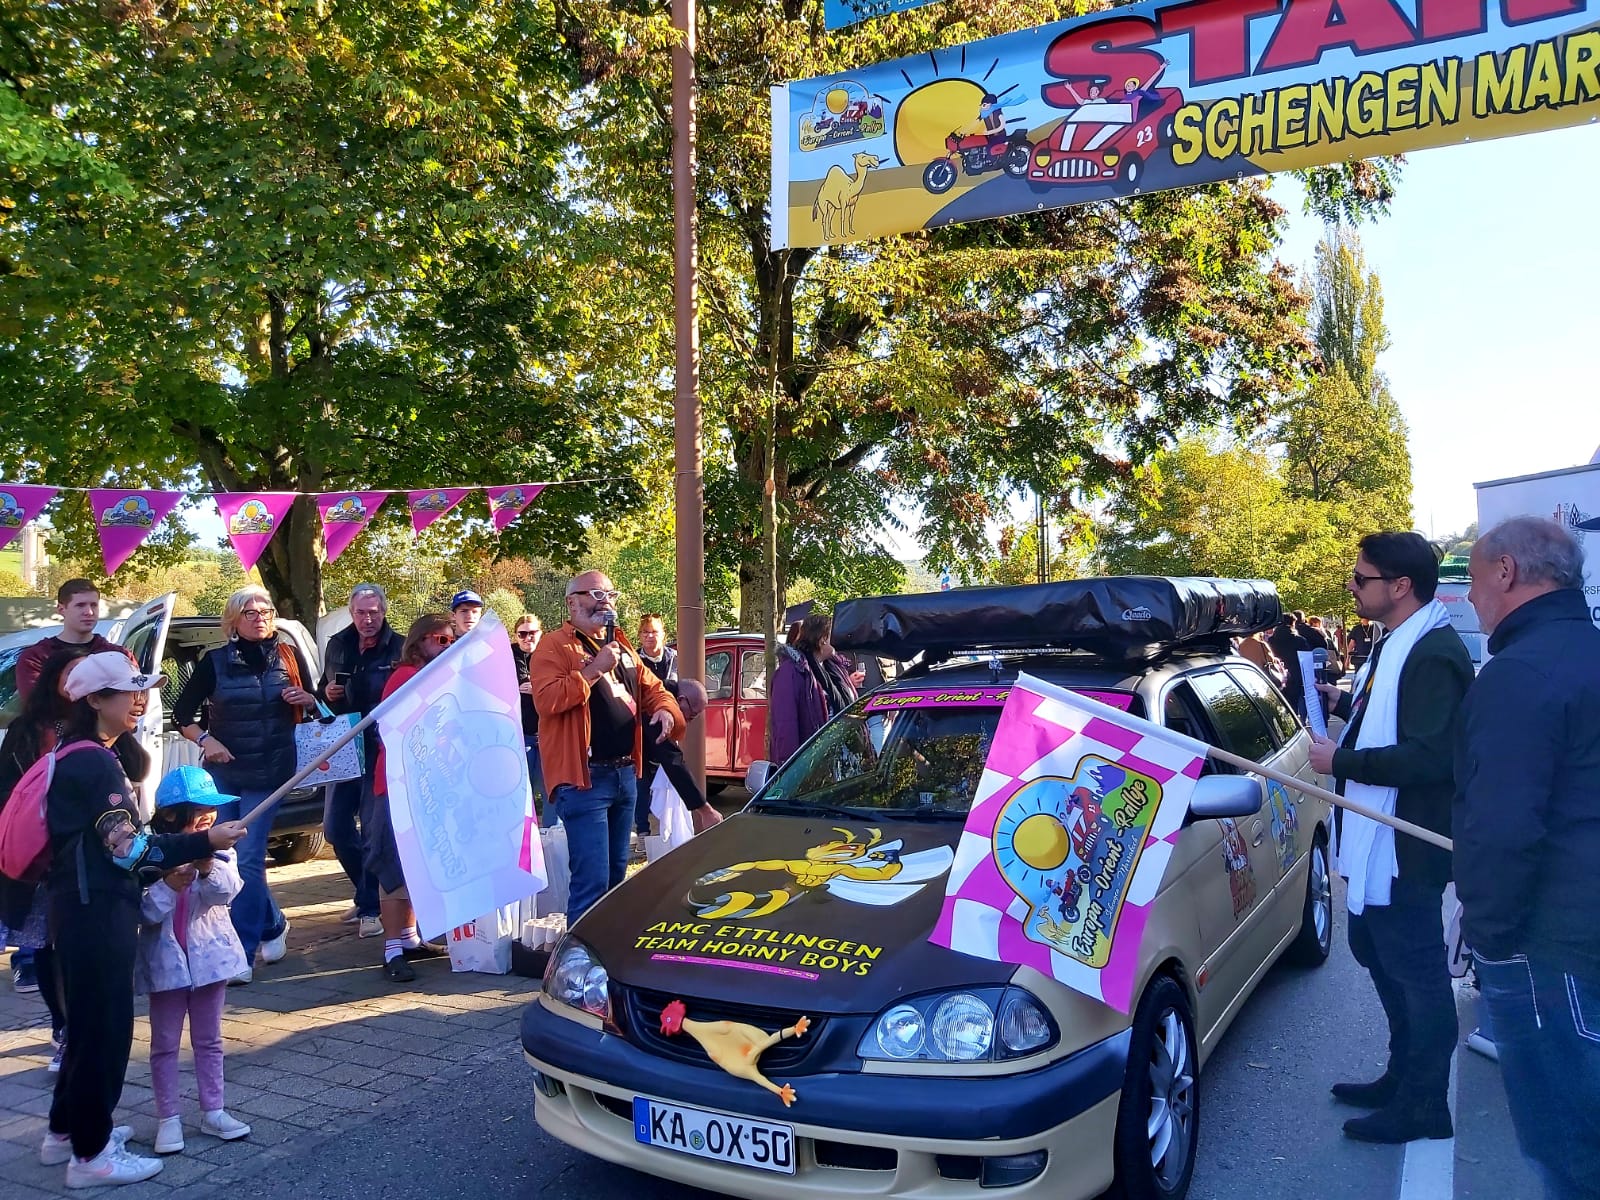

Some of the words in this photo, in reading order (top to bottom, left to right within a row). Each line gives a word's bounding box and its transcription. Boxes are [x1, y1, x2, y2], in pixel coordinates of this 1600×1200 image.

[1172, 55, 1462, 166] SCHENGEN
[1136, 124, 1153, 148] 23
[645, 921, 711, 935] AMC
[714, 925, 883, 959] ETTLINGEN
[1072, 900, 1105, 957] Europa
[634, 936, 700, 951] TEAM
[700, 939, 796, 962] HORNY
[799, 951, 872, 976] BOYS
[640, 1124, 647, 1134] D
[651, 1106, 687, 1148] KA
